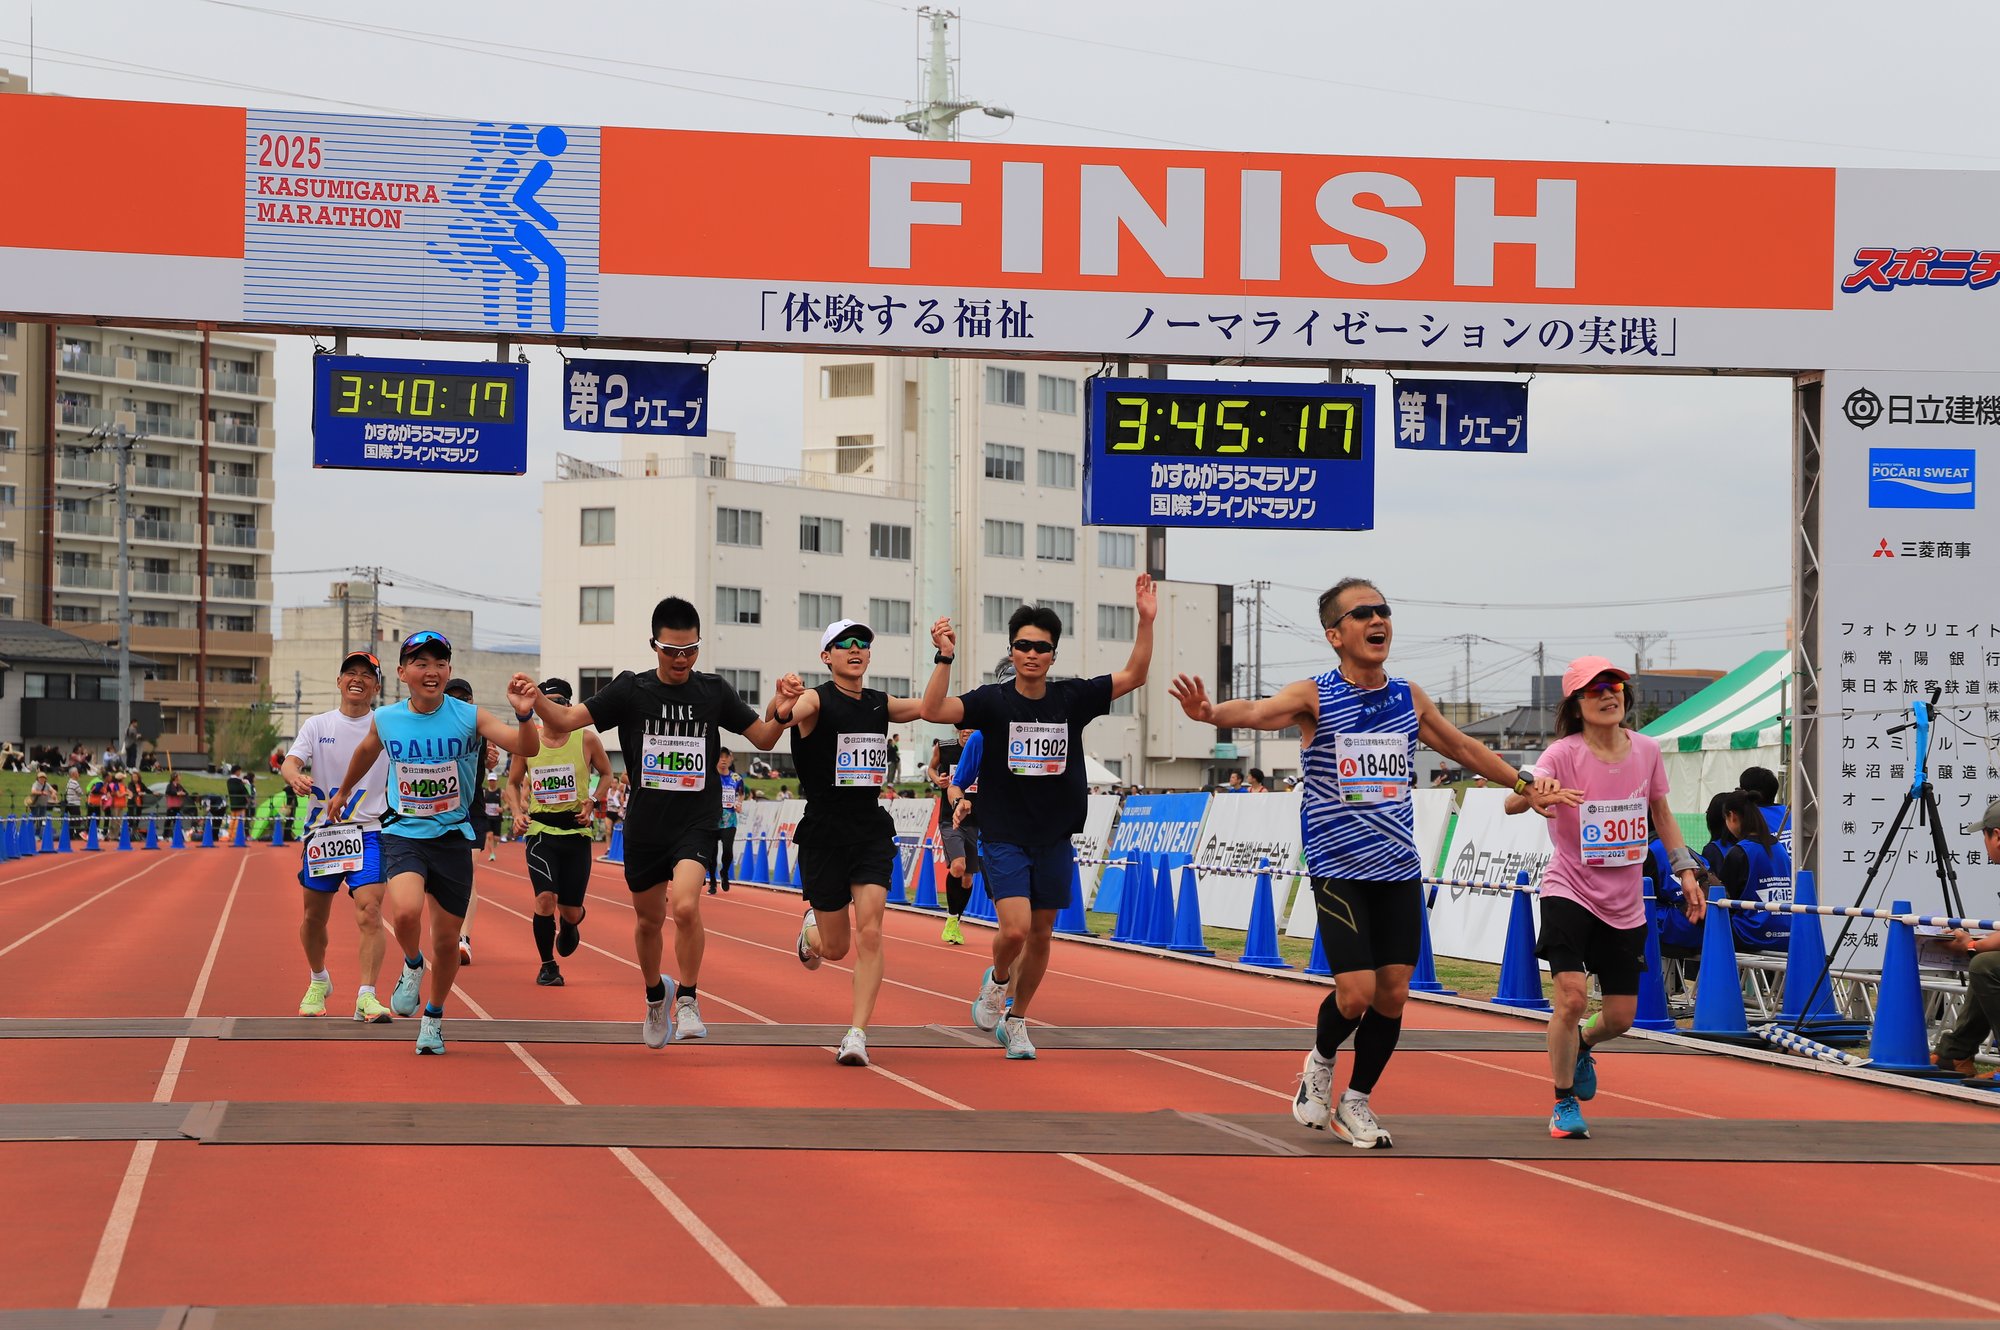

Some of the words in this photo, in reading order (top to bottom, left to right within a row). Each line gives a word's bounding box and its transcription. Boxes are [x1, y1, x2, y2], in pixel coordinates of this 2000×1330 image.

[258, 134, 322, 171] 2025
[257, 175, 441, 205] KASUMIGAURA
[257, 202, 403, 231] MARATHON
[868, 155, 1578, 290] FINISH
[1841, 247, 2000, 293] スポニチ
[760, 290, 1035, 339] 「体験する福祉
[1125, 306, 1678, 358] ノーマライゼーションの実践」
[337, 374, 508, 421] 3:40:17
[1889, 394, 2000, 426] 日立建機
[364, 423, 479, 447] かすみがうらマラソン
[1112, 397, 1356, 455] 3:45:17
[364, 444, 479, 464] 国際ブラインドマラソン
[1150, 463, 1317, 492] かすみがうらマラソン
[1872, 467, 1920, 477] POCARI
[1923, 467, 1969, 478] SWEAT
[1150, 493, 1317, 520] 国際ブラインドマラソン
[1900, 541, 1971, 559] 三菱商事
[661, 704, 694, 720] NIKE
[644, 719, 708, 738] RUNNING
[852, 749, 886, 767] 11932
[1025, 738, 1067, 756] 11902
[658, 751, 704, 772] 11560
[1358, 753, 1407, 776] 18409
[411, 776, 458, 797] 12032
[541, 774, 575, 790] 12948
[1112, 821, 1156, 852] POCARI
[1154, 821, 1200, 852] SWEAT
[1603, 817, 1647, 842] 3015
[321, 839, 361, 858] 13260
